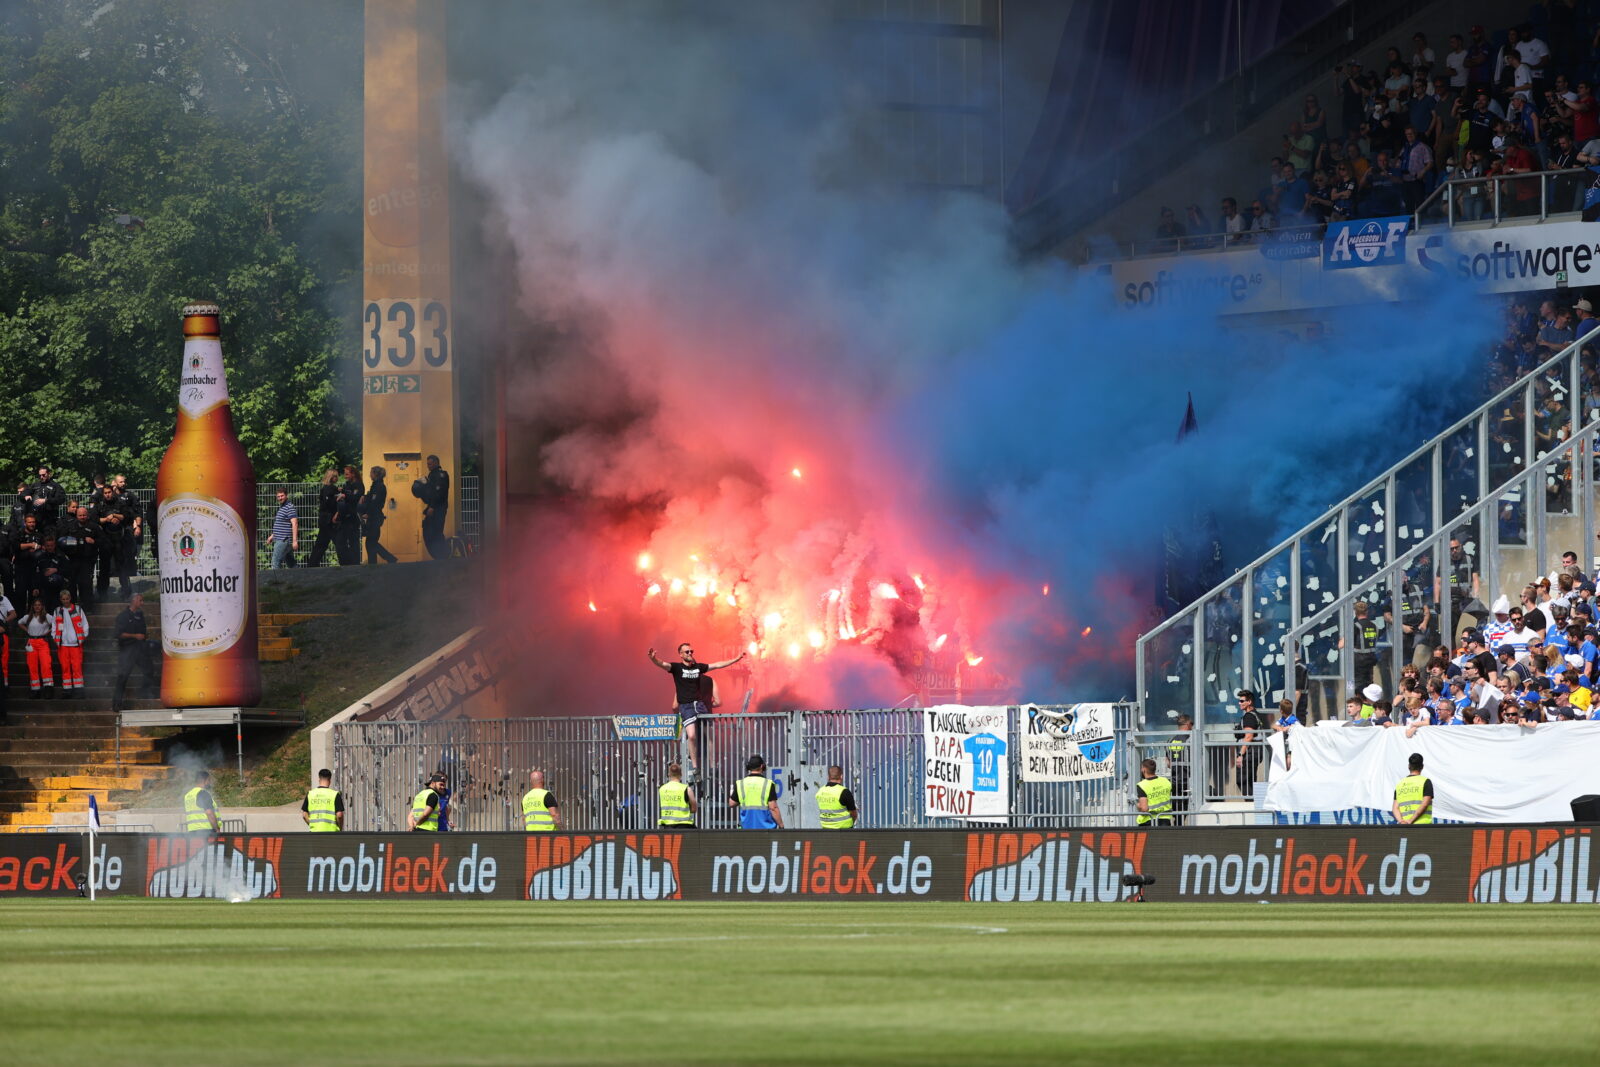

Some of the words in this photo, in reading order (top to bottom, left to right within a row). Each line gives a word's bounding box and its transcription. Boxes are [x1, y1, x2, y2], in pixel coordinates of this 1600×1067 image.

[1457, 241, 1593, 282] software
[1248, 272, 1263, 285] AG
[185, 387, 205, 401] Pils
[172, 608, 207, 635] Pils
[616, 715, 649, 726] SCHNAPS
[657, 715, 677, 726] WEED
[928, 711, 969, 734] TAUSCHE
[1088, 708, 1099, 724] SC
[934, 735, 963, 760] PAPA
[1089, 745, 1101, 760] 07
[926, 758, 961, 783] GEGEN
[977, 749, 993, 774] 10
[1029, 756, 1049, 775] DEIN
[1052, 754, 1084, 777] TRIKOT
[771, 768, 784, 799] 5
[926, 784, 976, 816] TRIKOT
[307, 843, 497, 893] mobilack.de
[524, 834, 683, 900] MOBILACK
[711, 840, 933, 895] mobilack.de
[1178, 837, 1431, 896] mobilack.de
[1467, 828, 1600, 904] MOBIL
